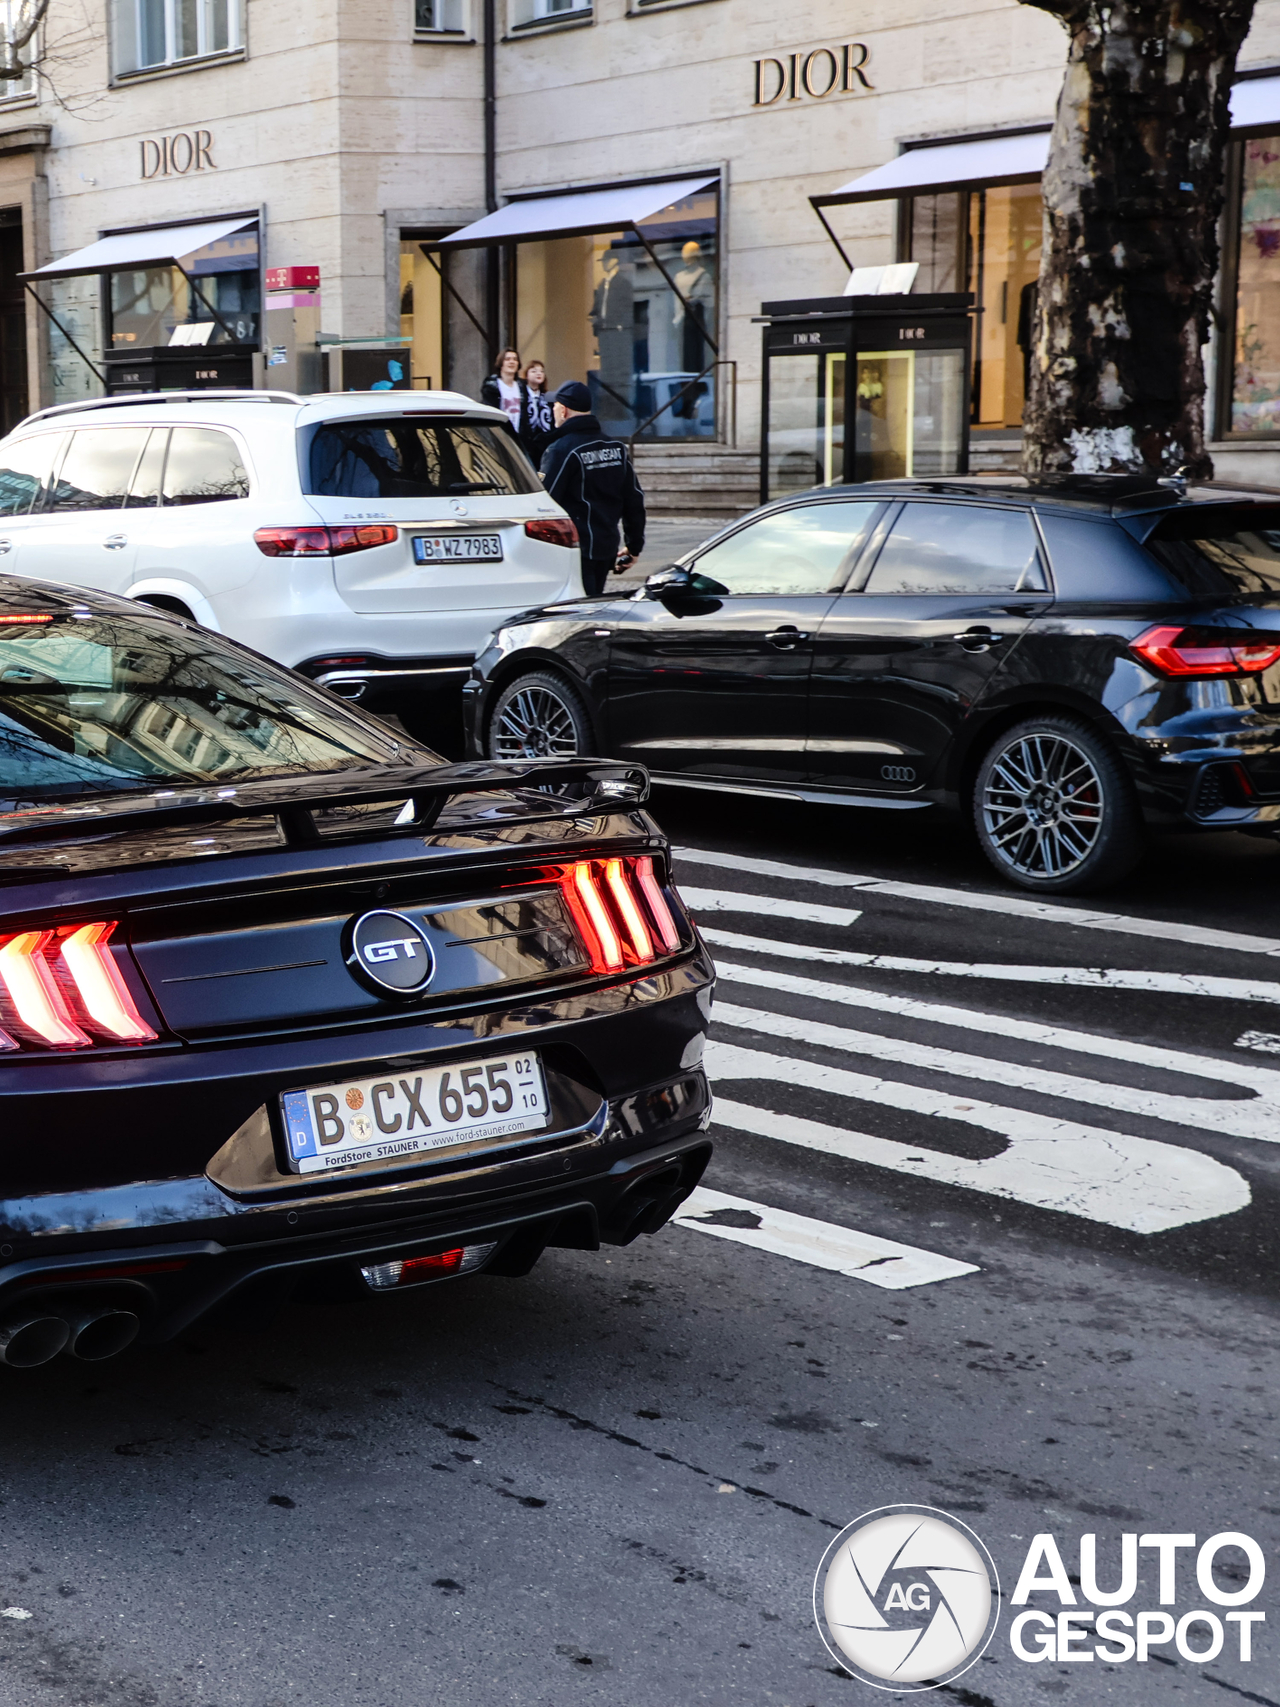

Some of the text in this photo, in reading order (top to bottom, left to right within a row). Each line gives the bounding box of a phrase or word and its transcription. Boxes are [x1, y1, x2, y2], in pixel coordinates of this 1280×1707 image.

[751, 43, 875, 107] DIOR
[138, 130, 218, 180] DIOR
[424, 538, 500, 557] B WZ 7983
[363, 936, 422, 964] GT
[514, 1058, 533, 1075] 02
[312, 1062, 515, 1146] B CX 655
[521, 1093, 539, 1109] 10
[296, 1130, 308, 1147] D
[324, 1119, 526, 1167] FordStore STAUNER www.ford-stauner.com
